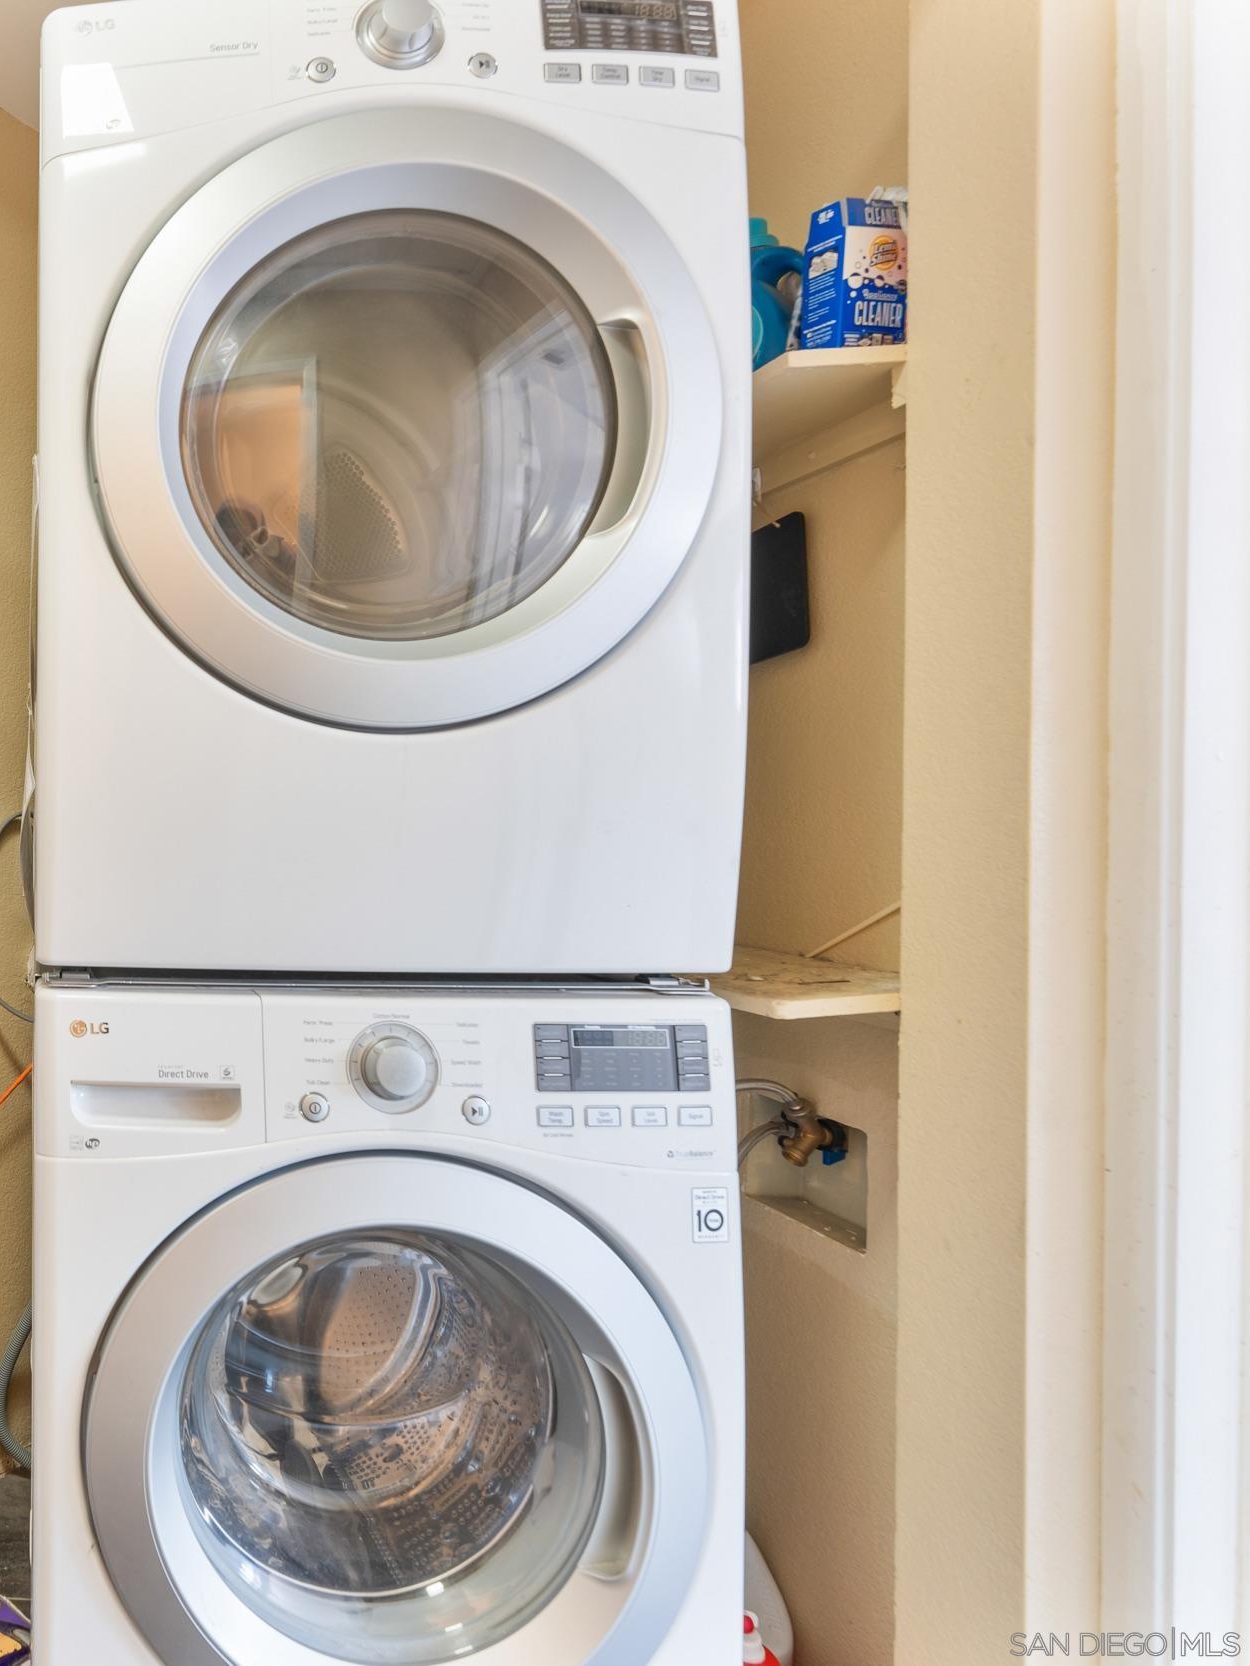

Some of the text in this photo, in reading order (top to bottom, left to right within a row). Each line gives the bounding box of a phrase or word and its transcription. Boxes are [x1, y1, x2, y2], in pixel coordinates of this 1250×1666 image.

[96, 19, 115, 31] LG
[209, 41, 259, 53] Sensor Dry
[854, 300, 903, 328] CLEANER
[90, 1022, 110, 1034] LG
[158, 1069, 209, 1079] Direct Drive
[696, 1209, 724, 1232] 10
